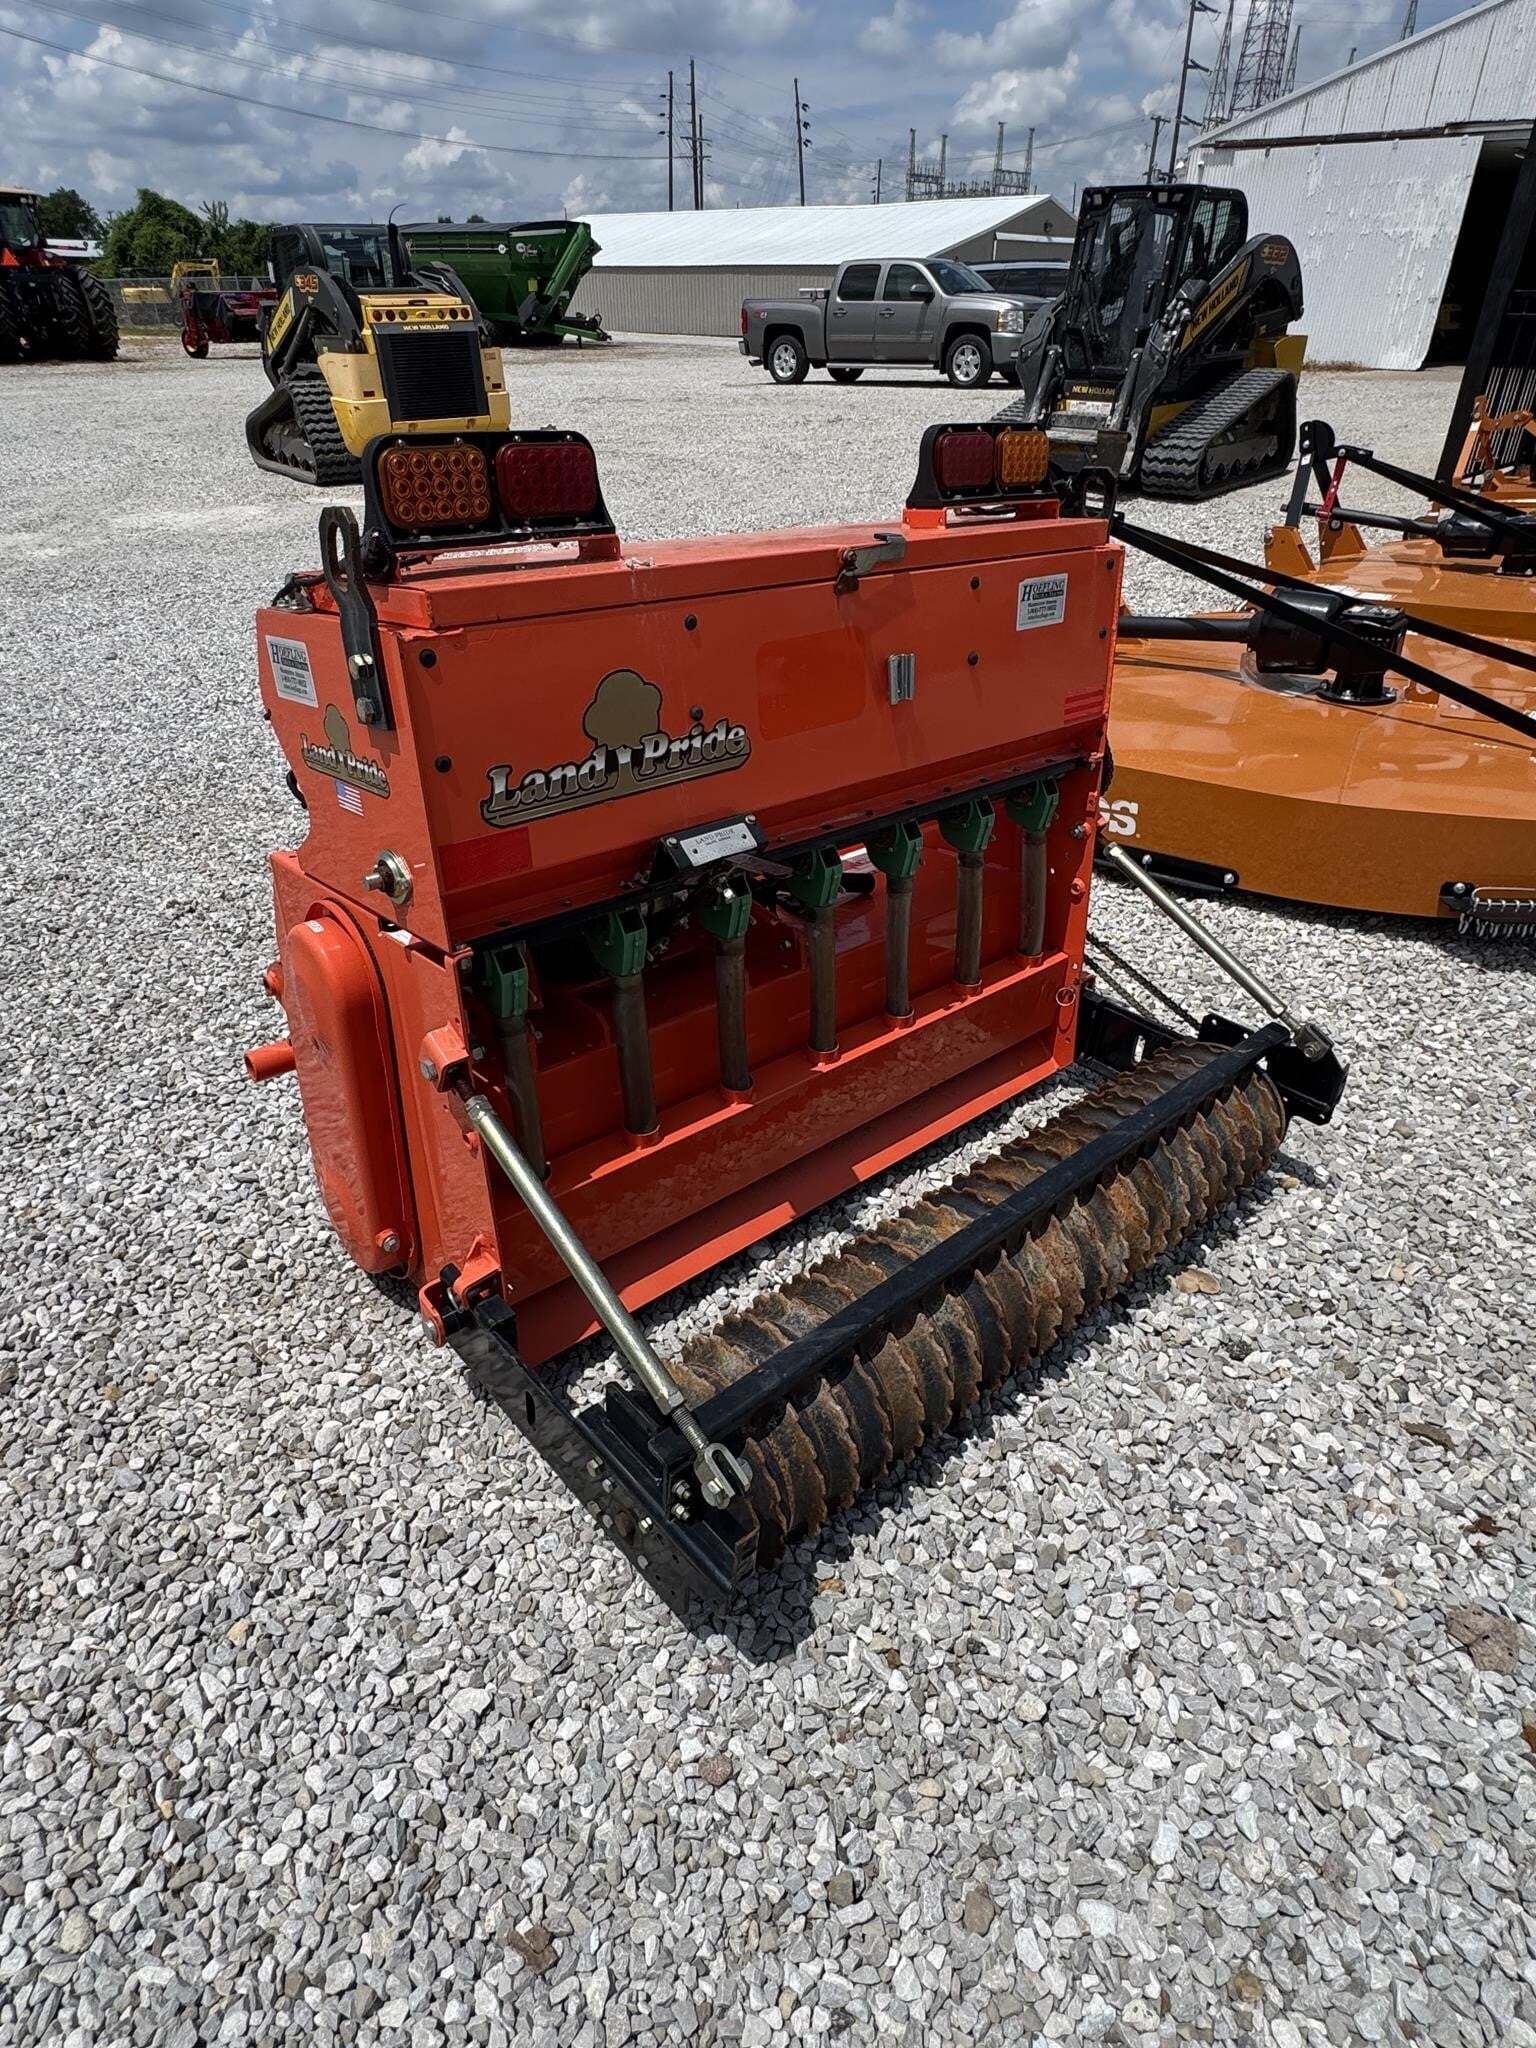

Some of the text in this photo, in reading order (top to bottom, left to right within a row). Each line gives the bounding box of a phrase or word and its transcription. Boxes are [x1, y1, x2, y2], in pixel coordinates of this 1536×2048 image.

[1072, 385, 1116, 396] NEW HOLLAN
[300, 733, 388, 790] Land Pride
[488, 719, 749, 811] Land Pride
[695, 833, 714, 845] LAND
[714, 828, 735, 839] PRIDE
